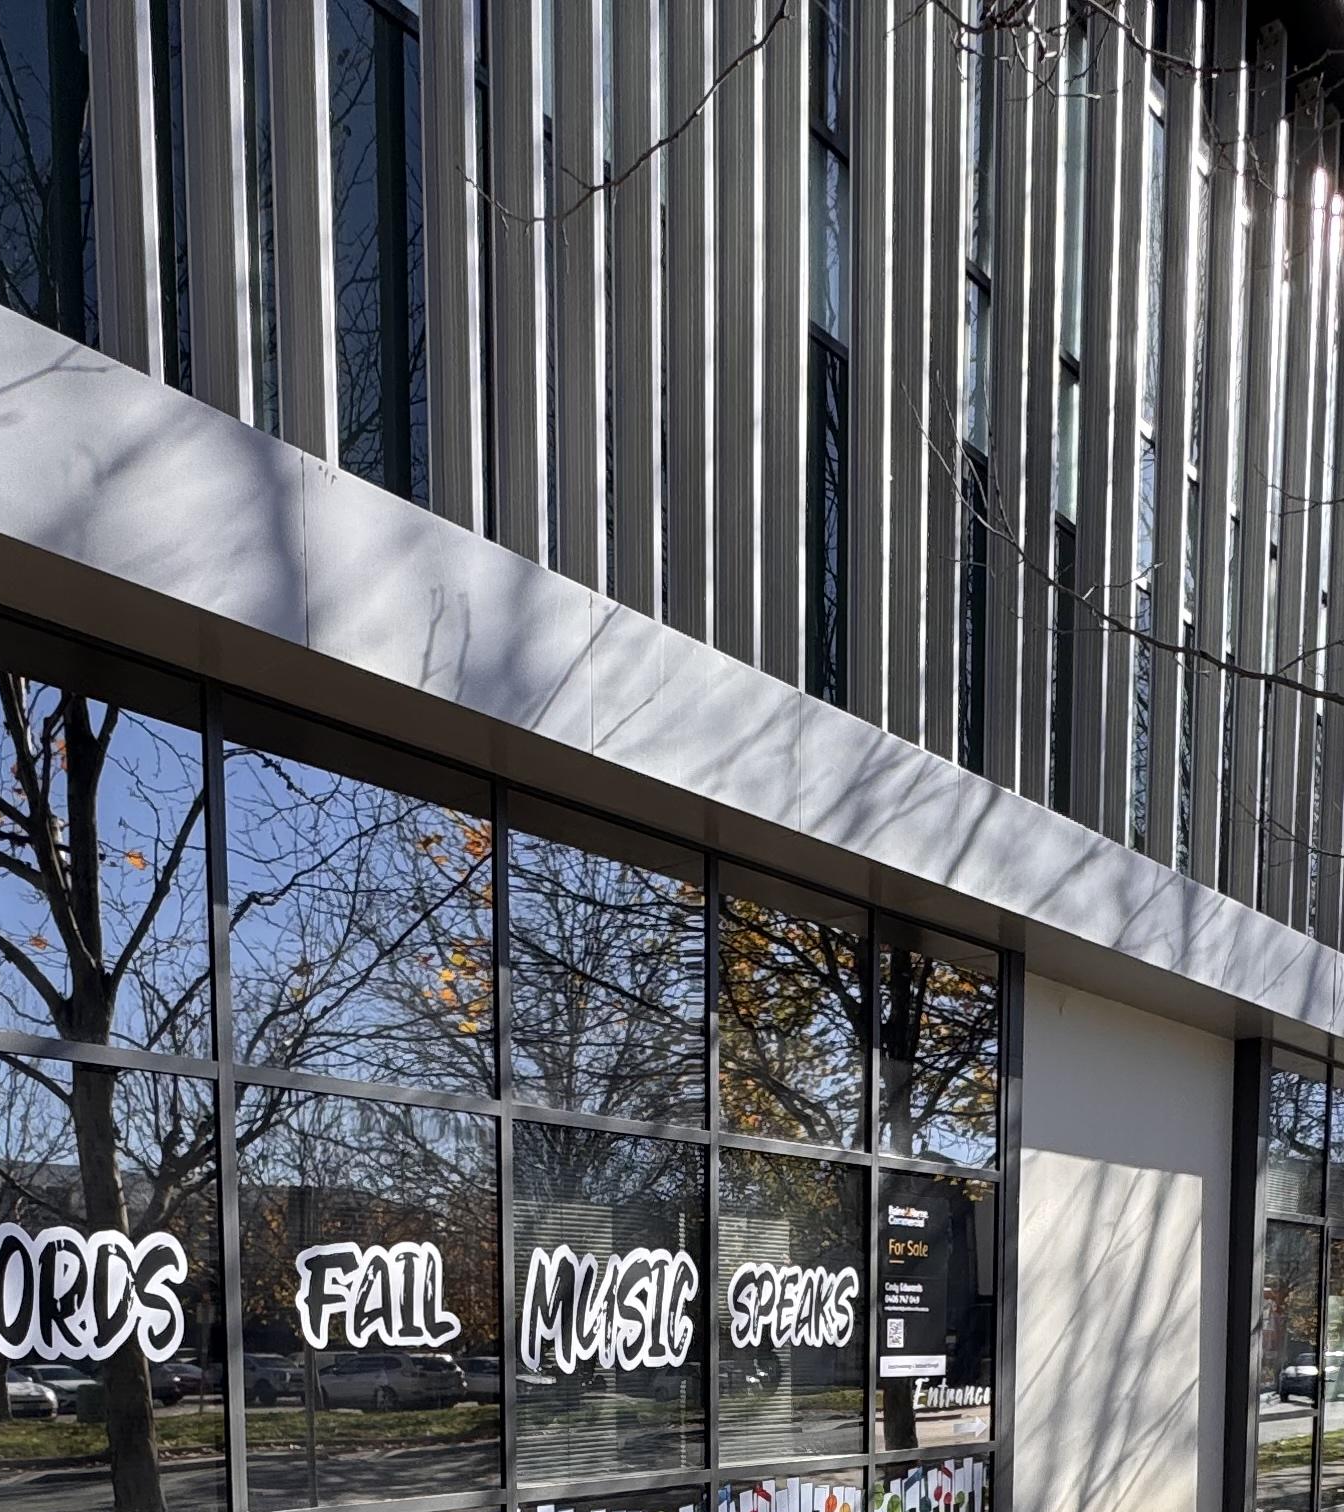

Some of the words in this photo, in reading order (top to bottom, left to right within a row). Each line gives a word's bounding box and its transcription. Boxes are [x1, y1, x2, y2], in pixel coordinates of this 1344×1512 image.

[888, 1238, 906, 1256] For
[907, 1239, 929, 1257] Sale
[296, 1242, 461, 1350] FAIL
[522, 1247, 699, 1374] MUSIC
[727, 1261, 858, 1350] SPEAKS
[913, 1377, 991, 1410] Entrance
